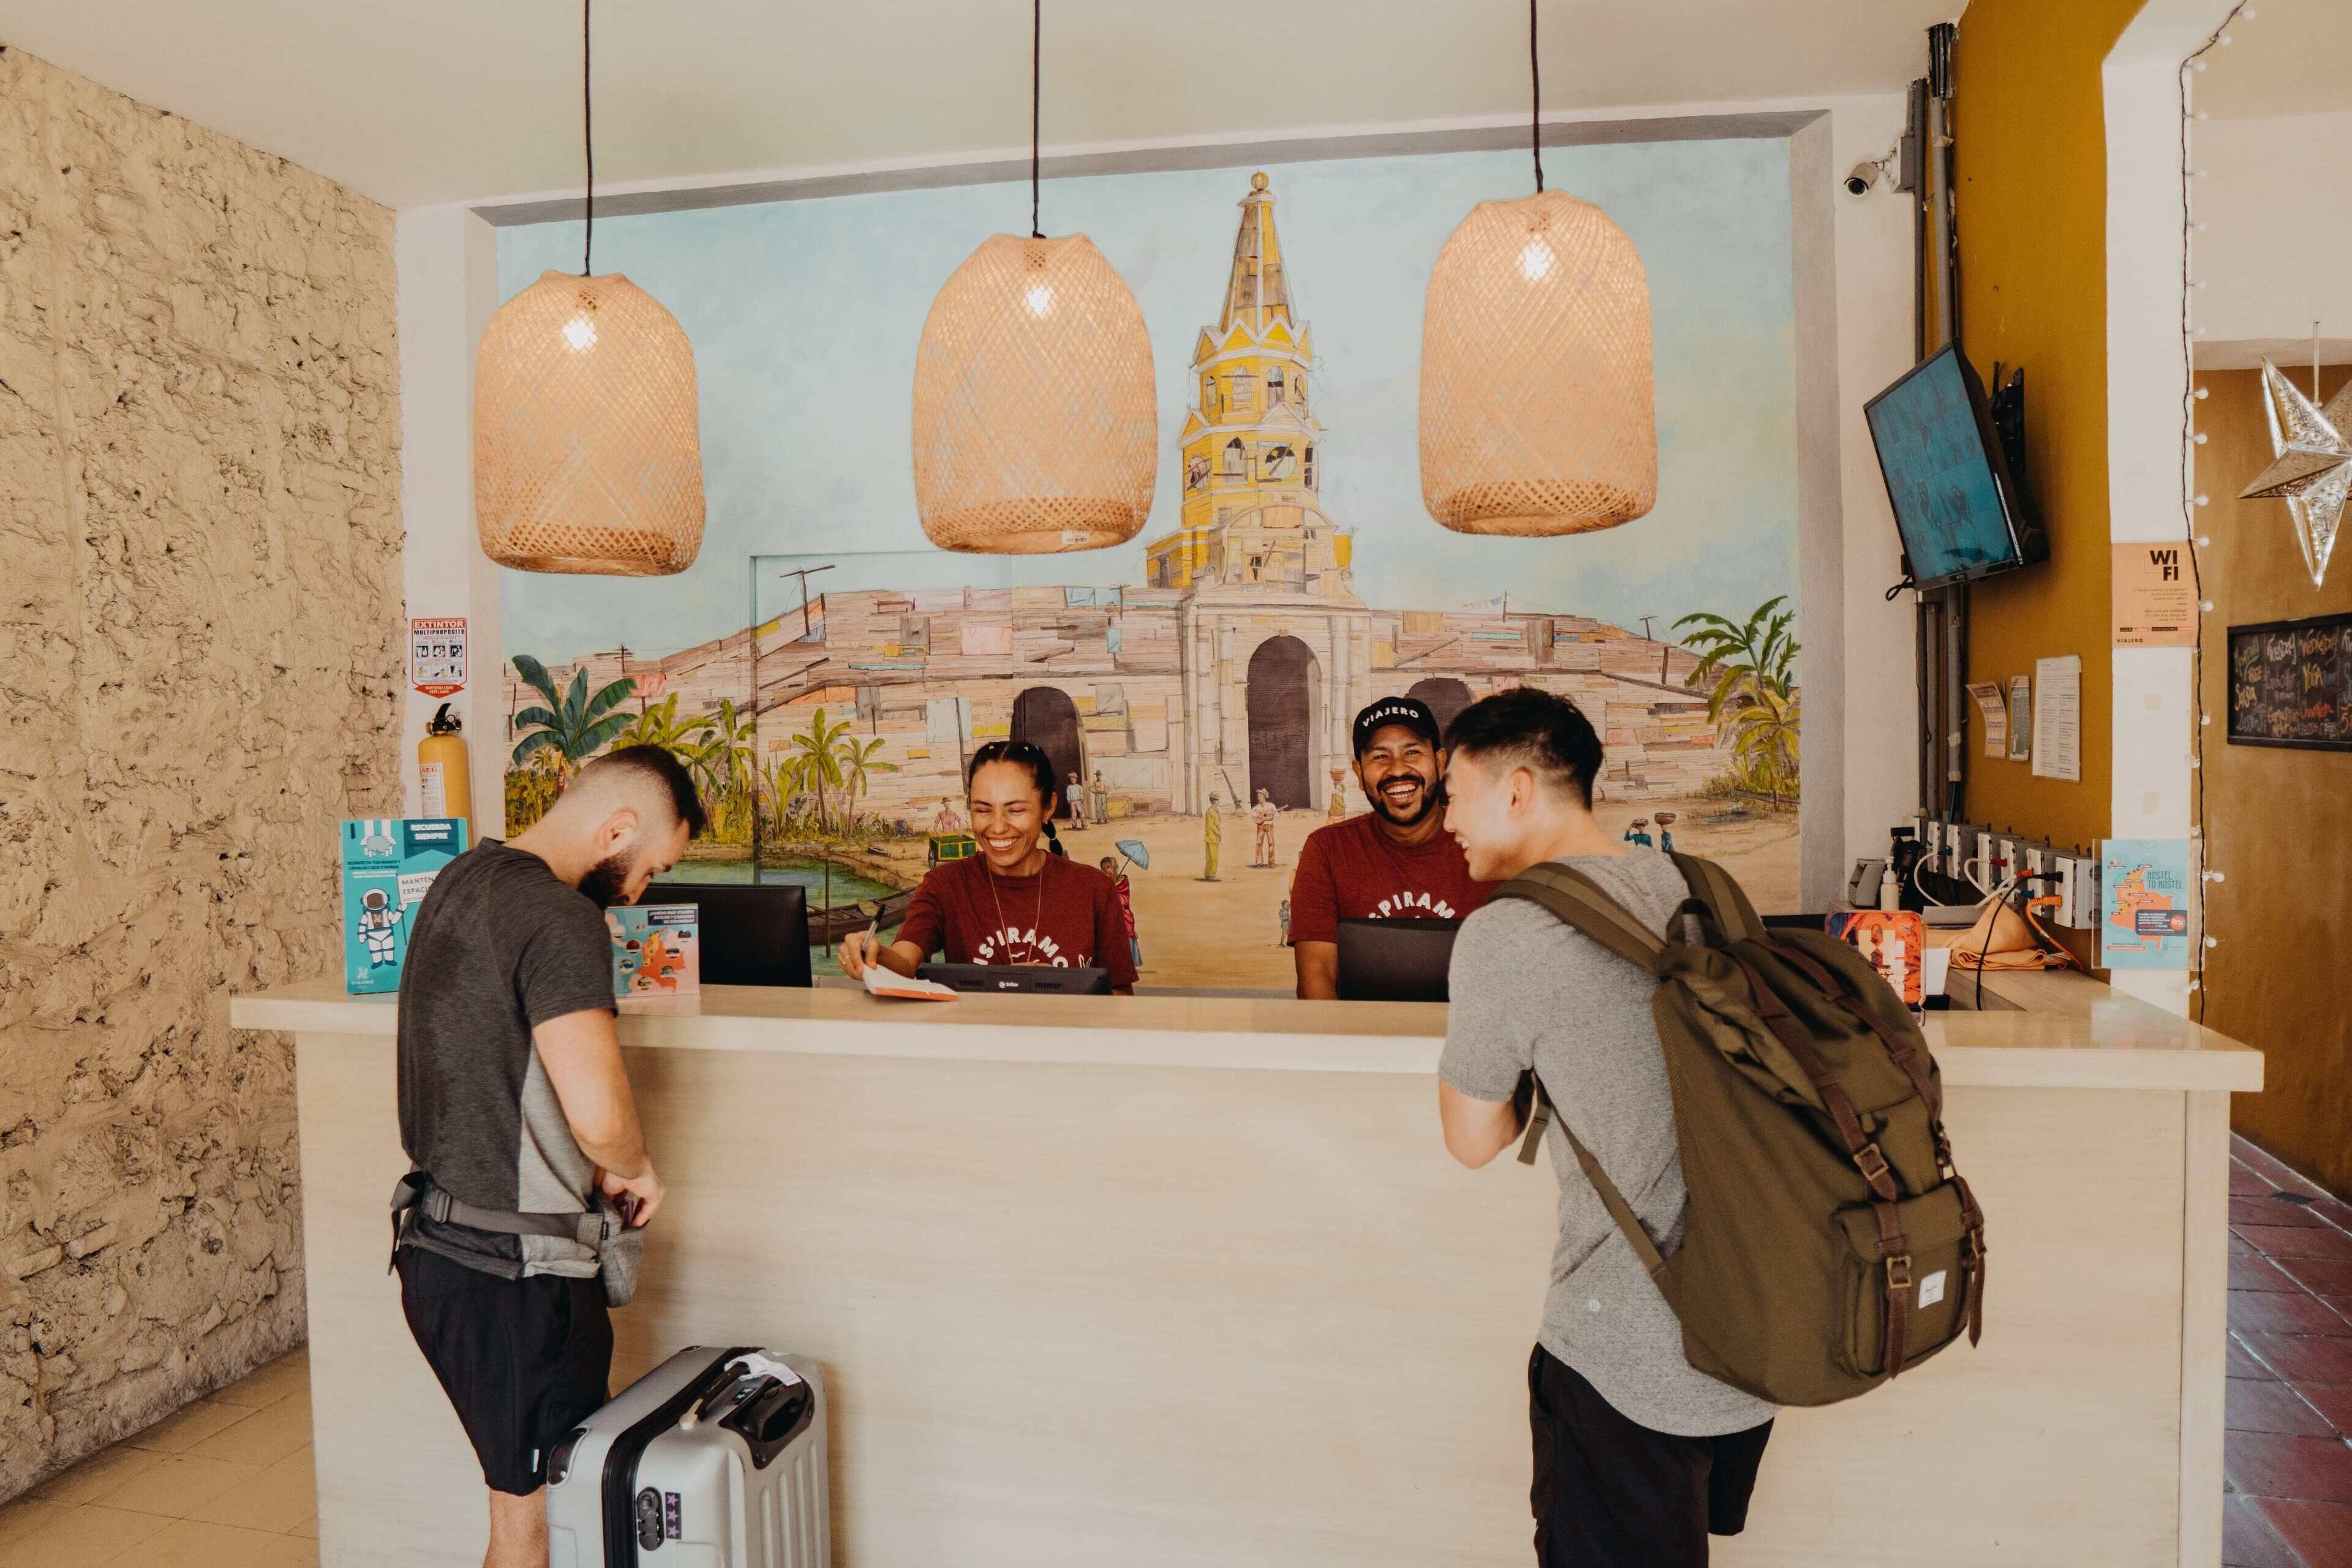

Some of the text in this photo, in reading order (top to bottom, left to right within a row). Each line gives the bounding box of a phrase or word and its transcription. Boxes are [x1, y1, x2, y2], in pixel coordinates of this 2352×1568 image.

[2149, 550, 2177, 565] WI
[2163, 566, 2179, 581] FI
[1362, 707, 1419, 727] VIAJERO
[2147, 870, 2173, 880] HOSTEL
[2148, 880, 2157, 889] TO
[2158, 880, 2183, 889] HOSTEL
[1368, 891, 1456, 919] PIRAM
